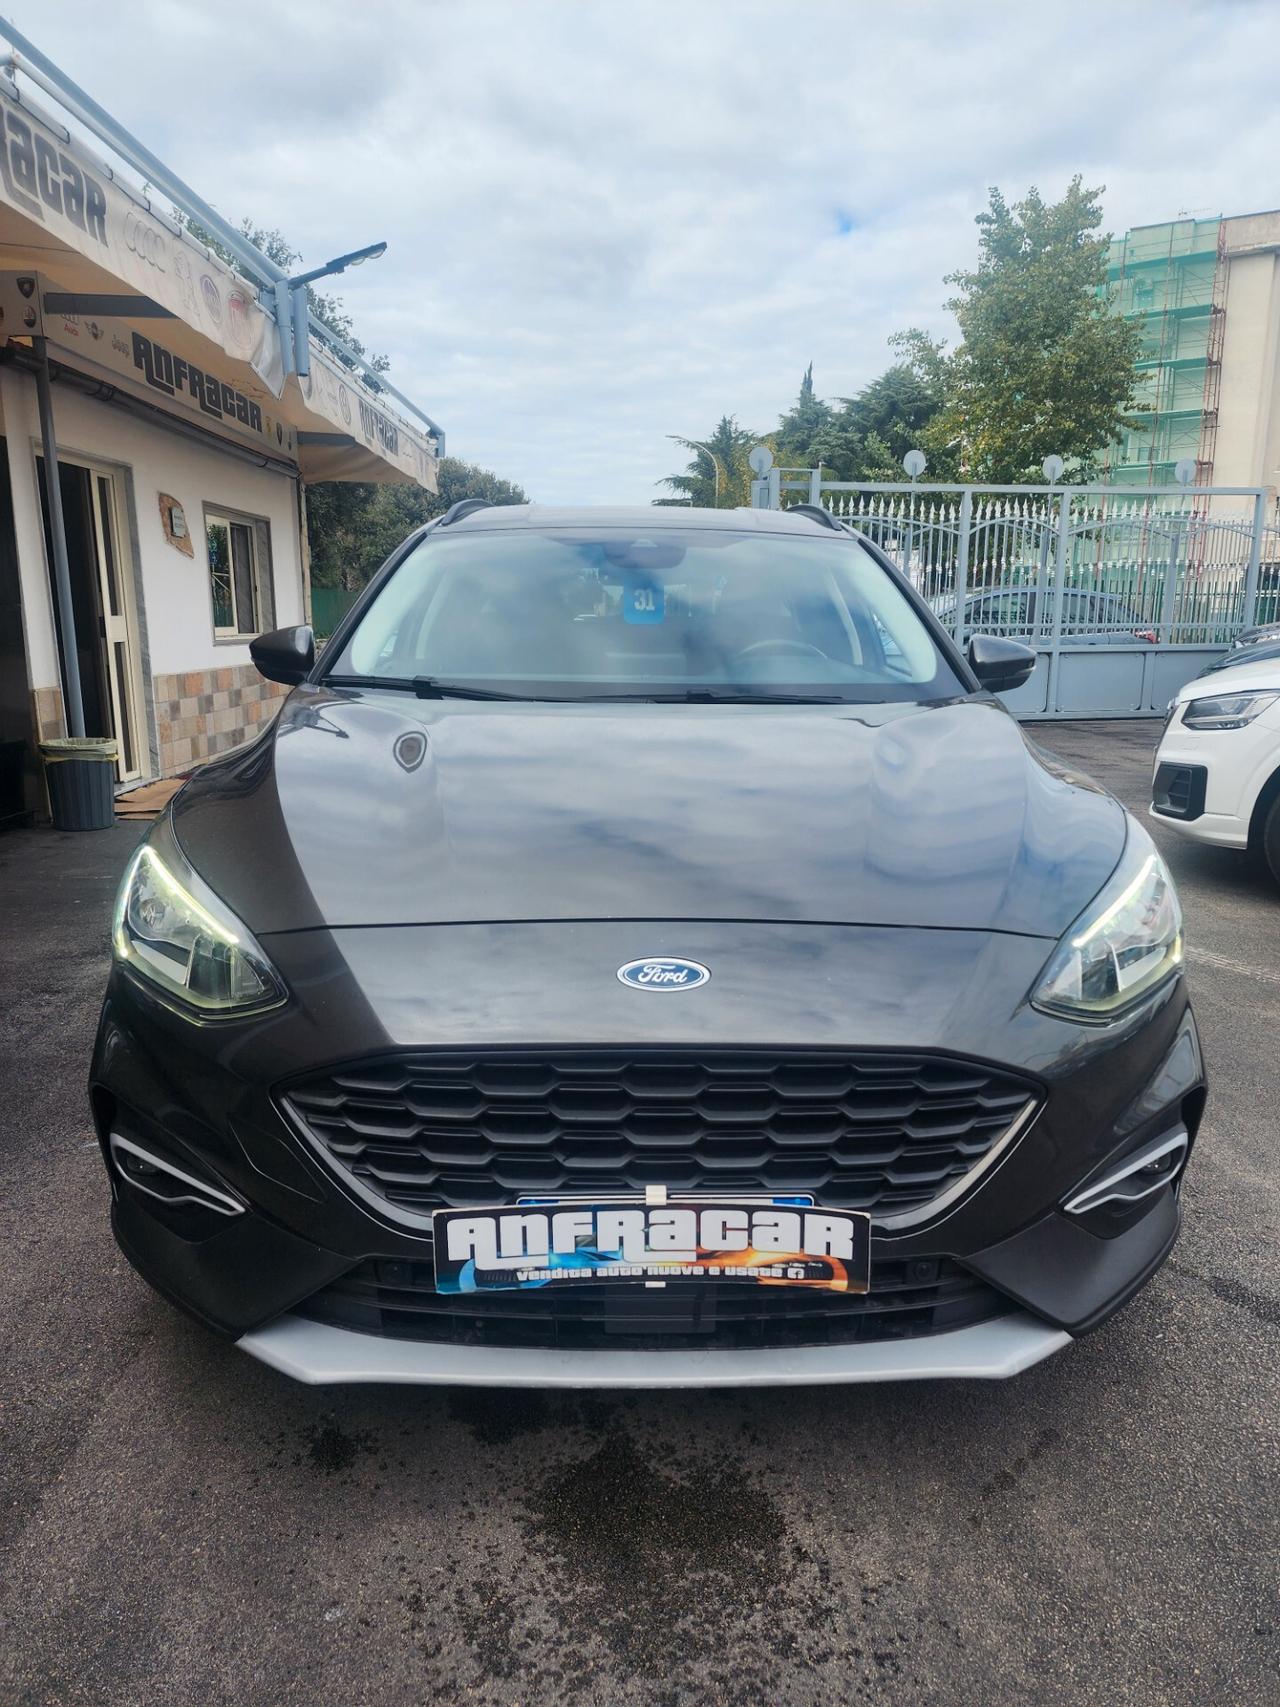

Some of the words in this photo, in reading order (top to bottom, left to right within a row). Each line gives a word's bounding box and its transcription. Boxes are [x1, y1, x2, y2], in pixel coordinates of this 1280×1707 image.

[633, 589, 656, 611] 31
[638, 964, 688, 983] Ford
[596, 1267, 643, 1277] auto
[647, 1266, 704, 1276] nuove
